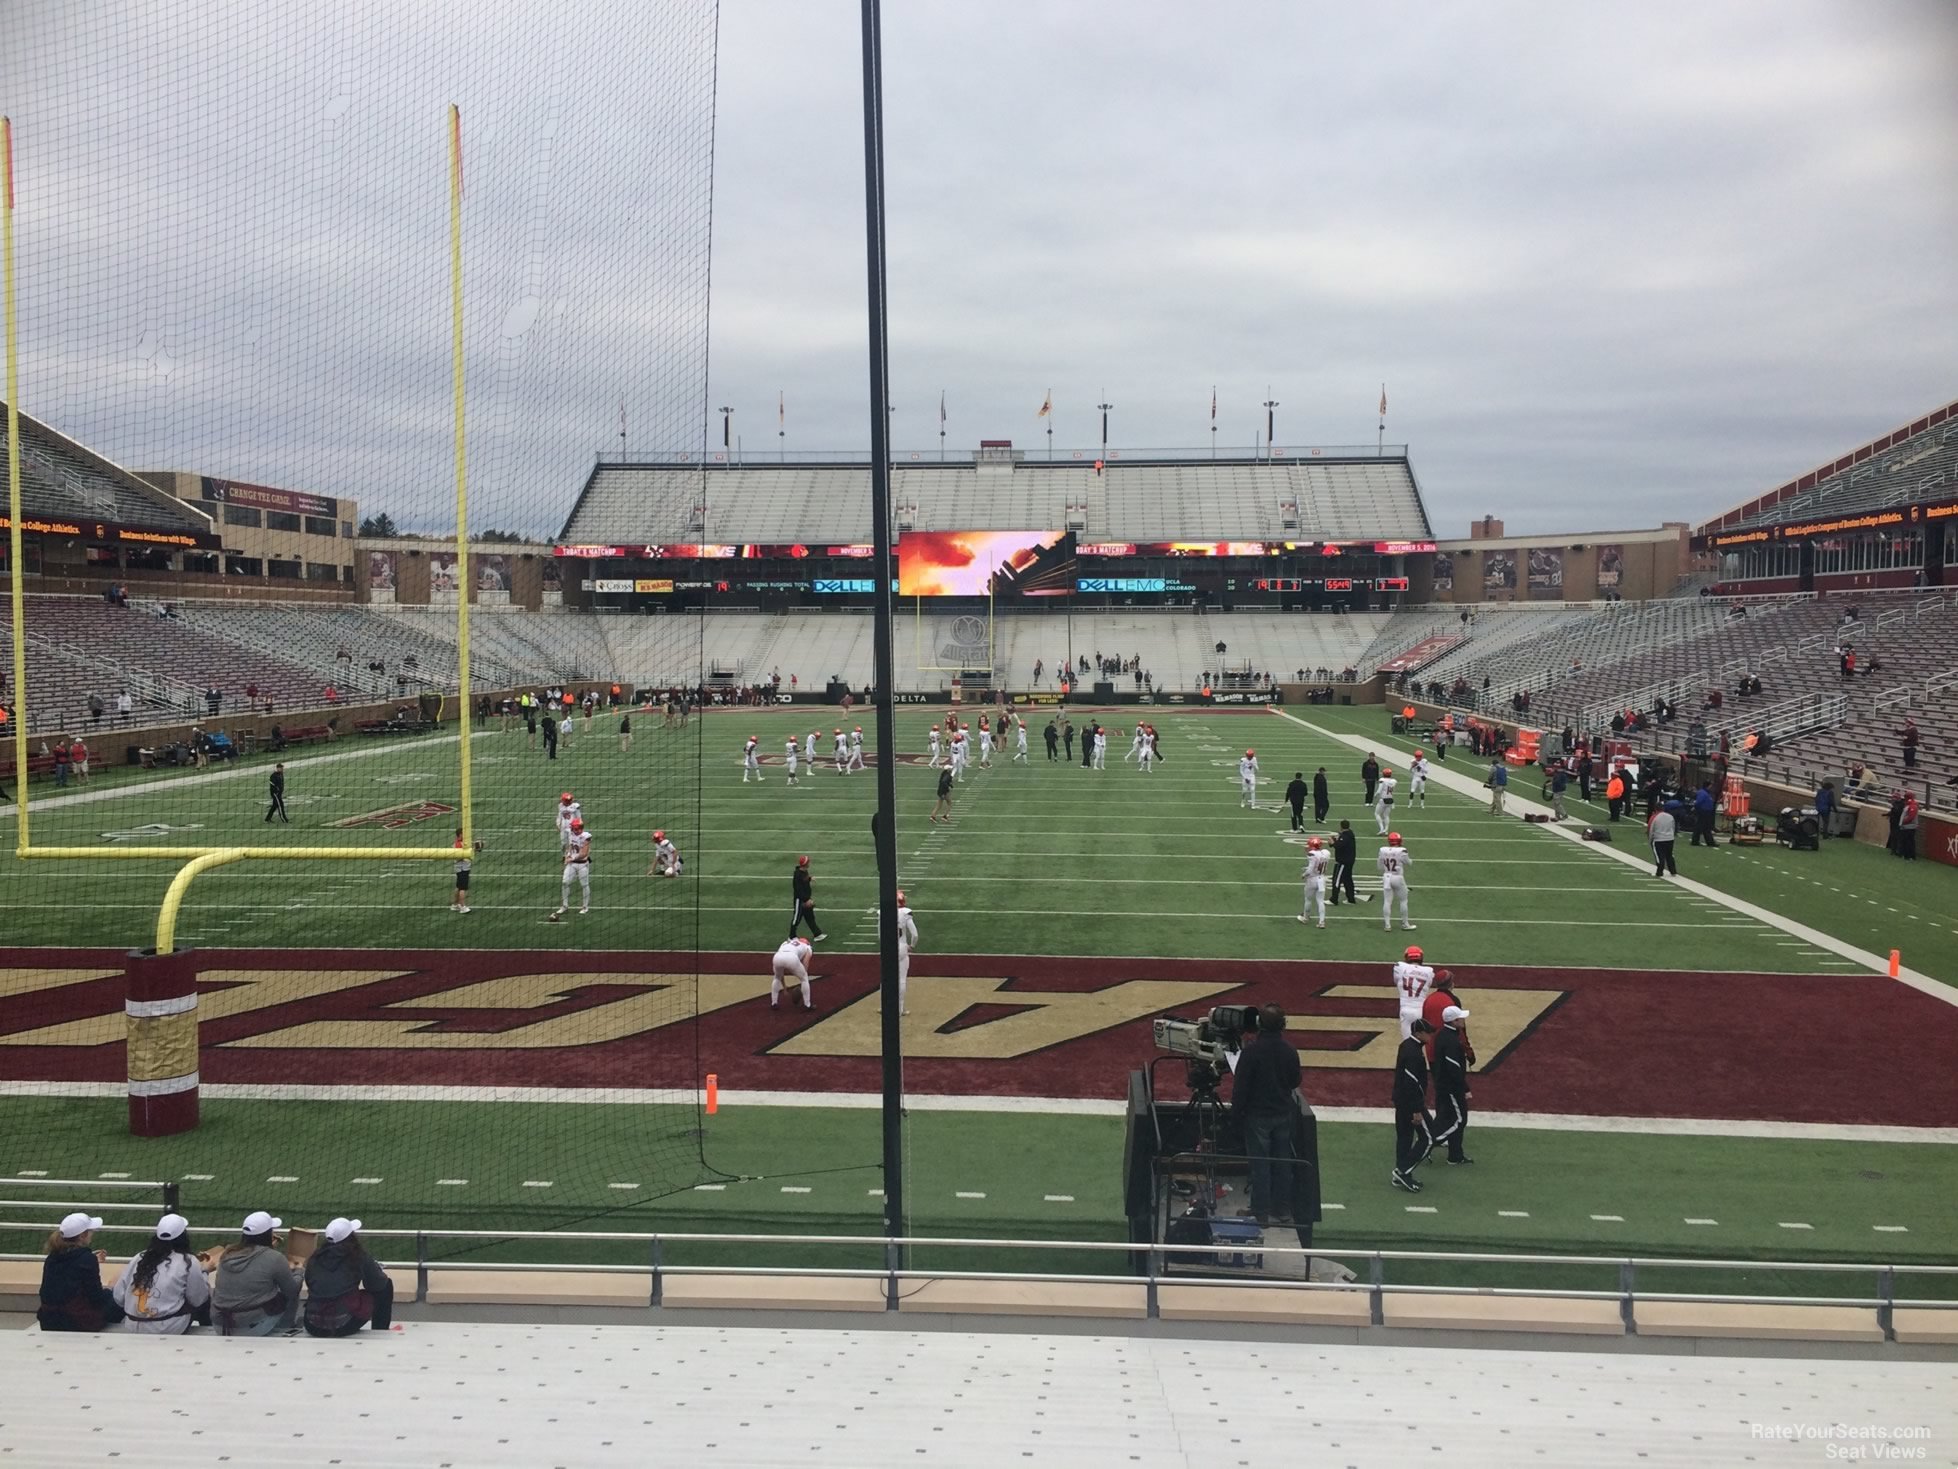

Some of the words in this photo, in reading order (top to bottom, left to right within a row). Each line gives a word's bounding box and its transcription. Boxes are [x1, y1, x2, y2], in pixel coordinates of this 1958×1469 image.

[1927, 506, 1951, 518] Business
[27, 520, 51, 533] College
[1860, 516, 1878, 528] College
[1099, 546, 1127, 554] MATCHUP
[716, 582, 728, 592] 19
[815, 582, 858, 592] DELL
[1079, 580, 1124, 591] DELL
[1126, 580, 1165, 590] EMC
[1258, 580, 1267, 590] 19
[1402, 976, 1426, 997] 47
